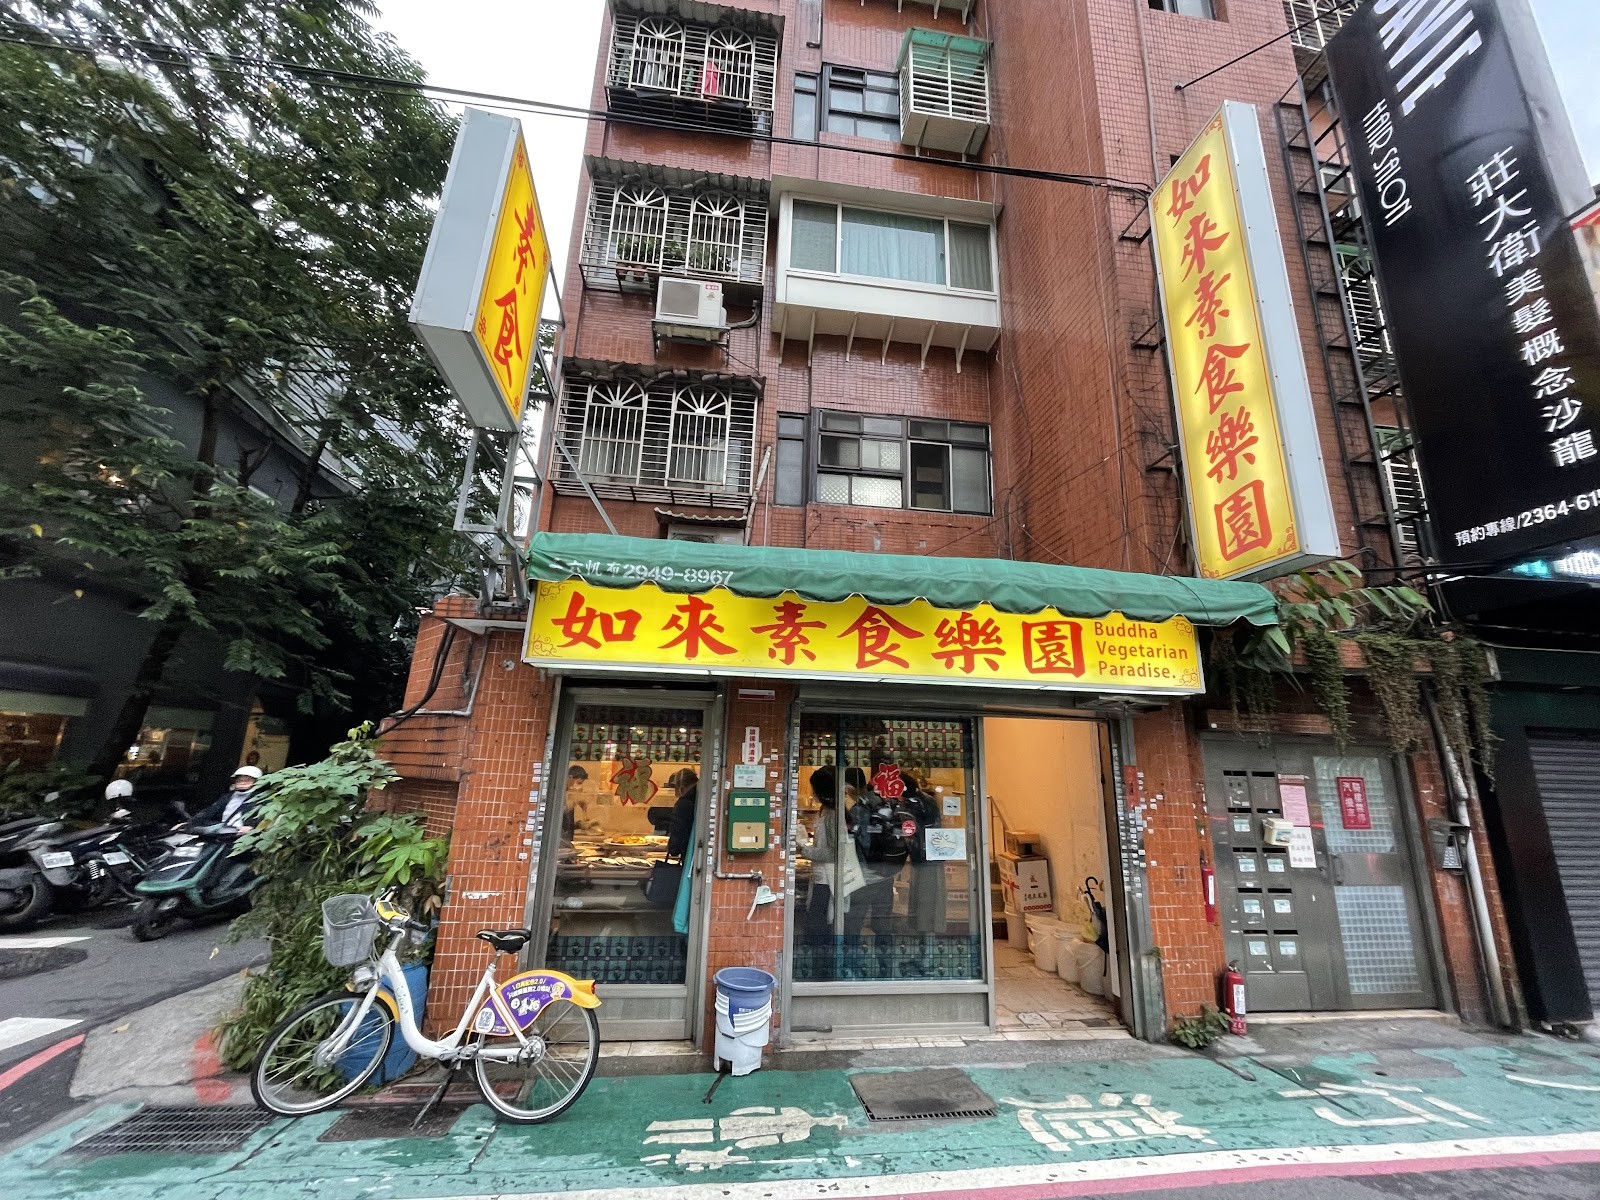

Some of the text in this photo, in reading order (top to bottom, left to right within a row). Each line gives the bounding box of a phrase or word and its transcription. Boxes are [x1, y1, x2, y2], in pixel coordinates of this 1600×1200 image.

[1373, 0, 1482, 117] AVIE
[1373, 147, 1412, 227] SALON
[1465, 145, 1599, 468] 莊大衛美髮概念沙龍
[1166, 153, 1270, 562] 如來素食樂園
[1454, 489, 1600, 546] 預約專線/2364-61
[551, 591, 1086, 677] 如來素食樂園
[1095, 621, 1158, 639] Buddha
[1096, 640, 1188, 660] Vegetarian
[1098, 660, 1176, 679] Paradise.
[873, 762, 906, 798] 福
